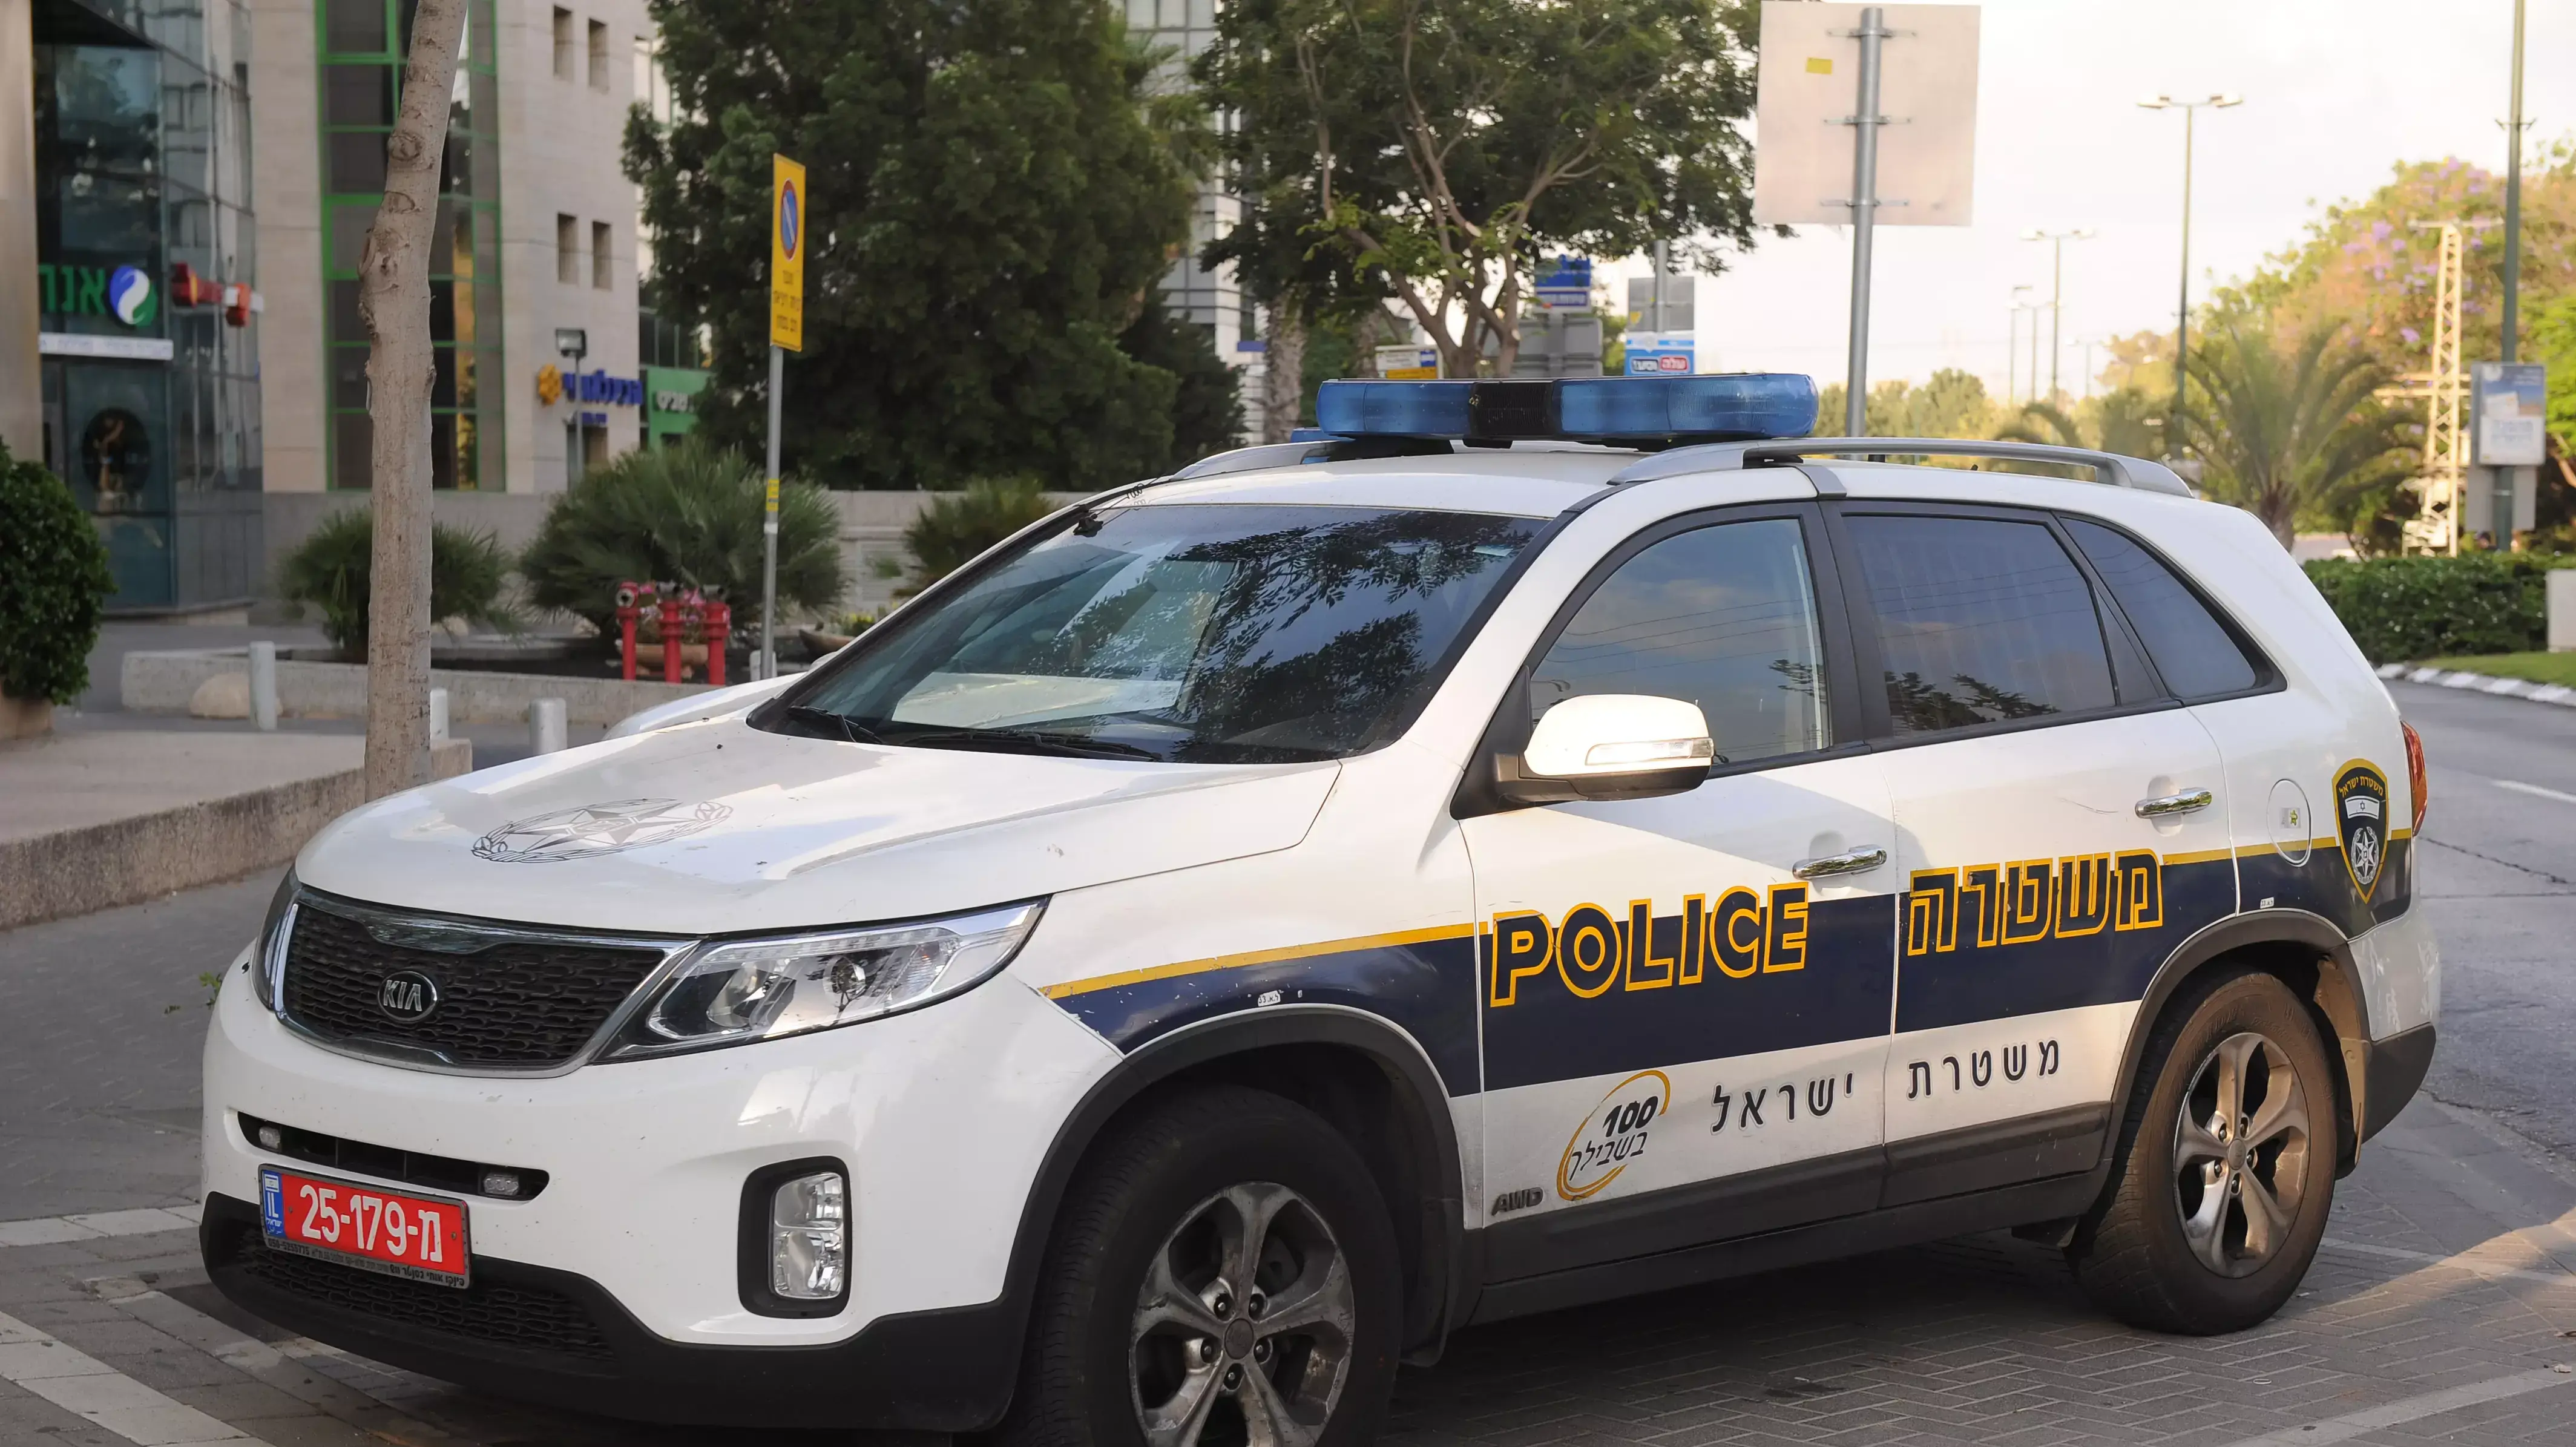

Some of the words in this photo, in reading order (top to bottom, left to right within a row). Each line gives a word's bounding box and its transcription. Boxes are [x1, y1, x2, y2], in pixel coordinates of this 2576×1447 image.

[2338, 776, 2359, 798] ישראל
[2360, 776, 2384, 796] משטרת
[1907, 848, 2163, 956] משטרה
[1490, 882, 1809, 1008] POLICE
[383, 979, 422, 1012] KIA
[1908, 1039, 2059, 1099] משטרת
[1603, 1096, 1659, 1137] 100
[1712, 1072, 1853, 1132] ישראל
[1569, 1131, 1648, 1181] בשבילך
[267, 1191, 279, 1218] IL
[1491, 1187, 1543, 1216] AWD
